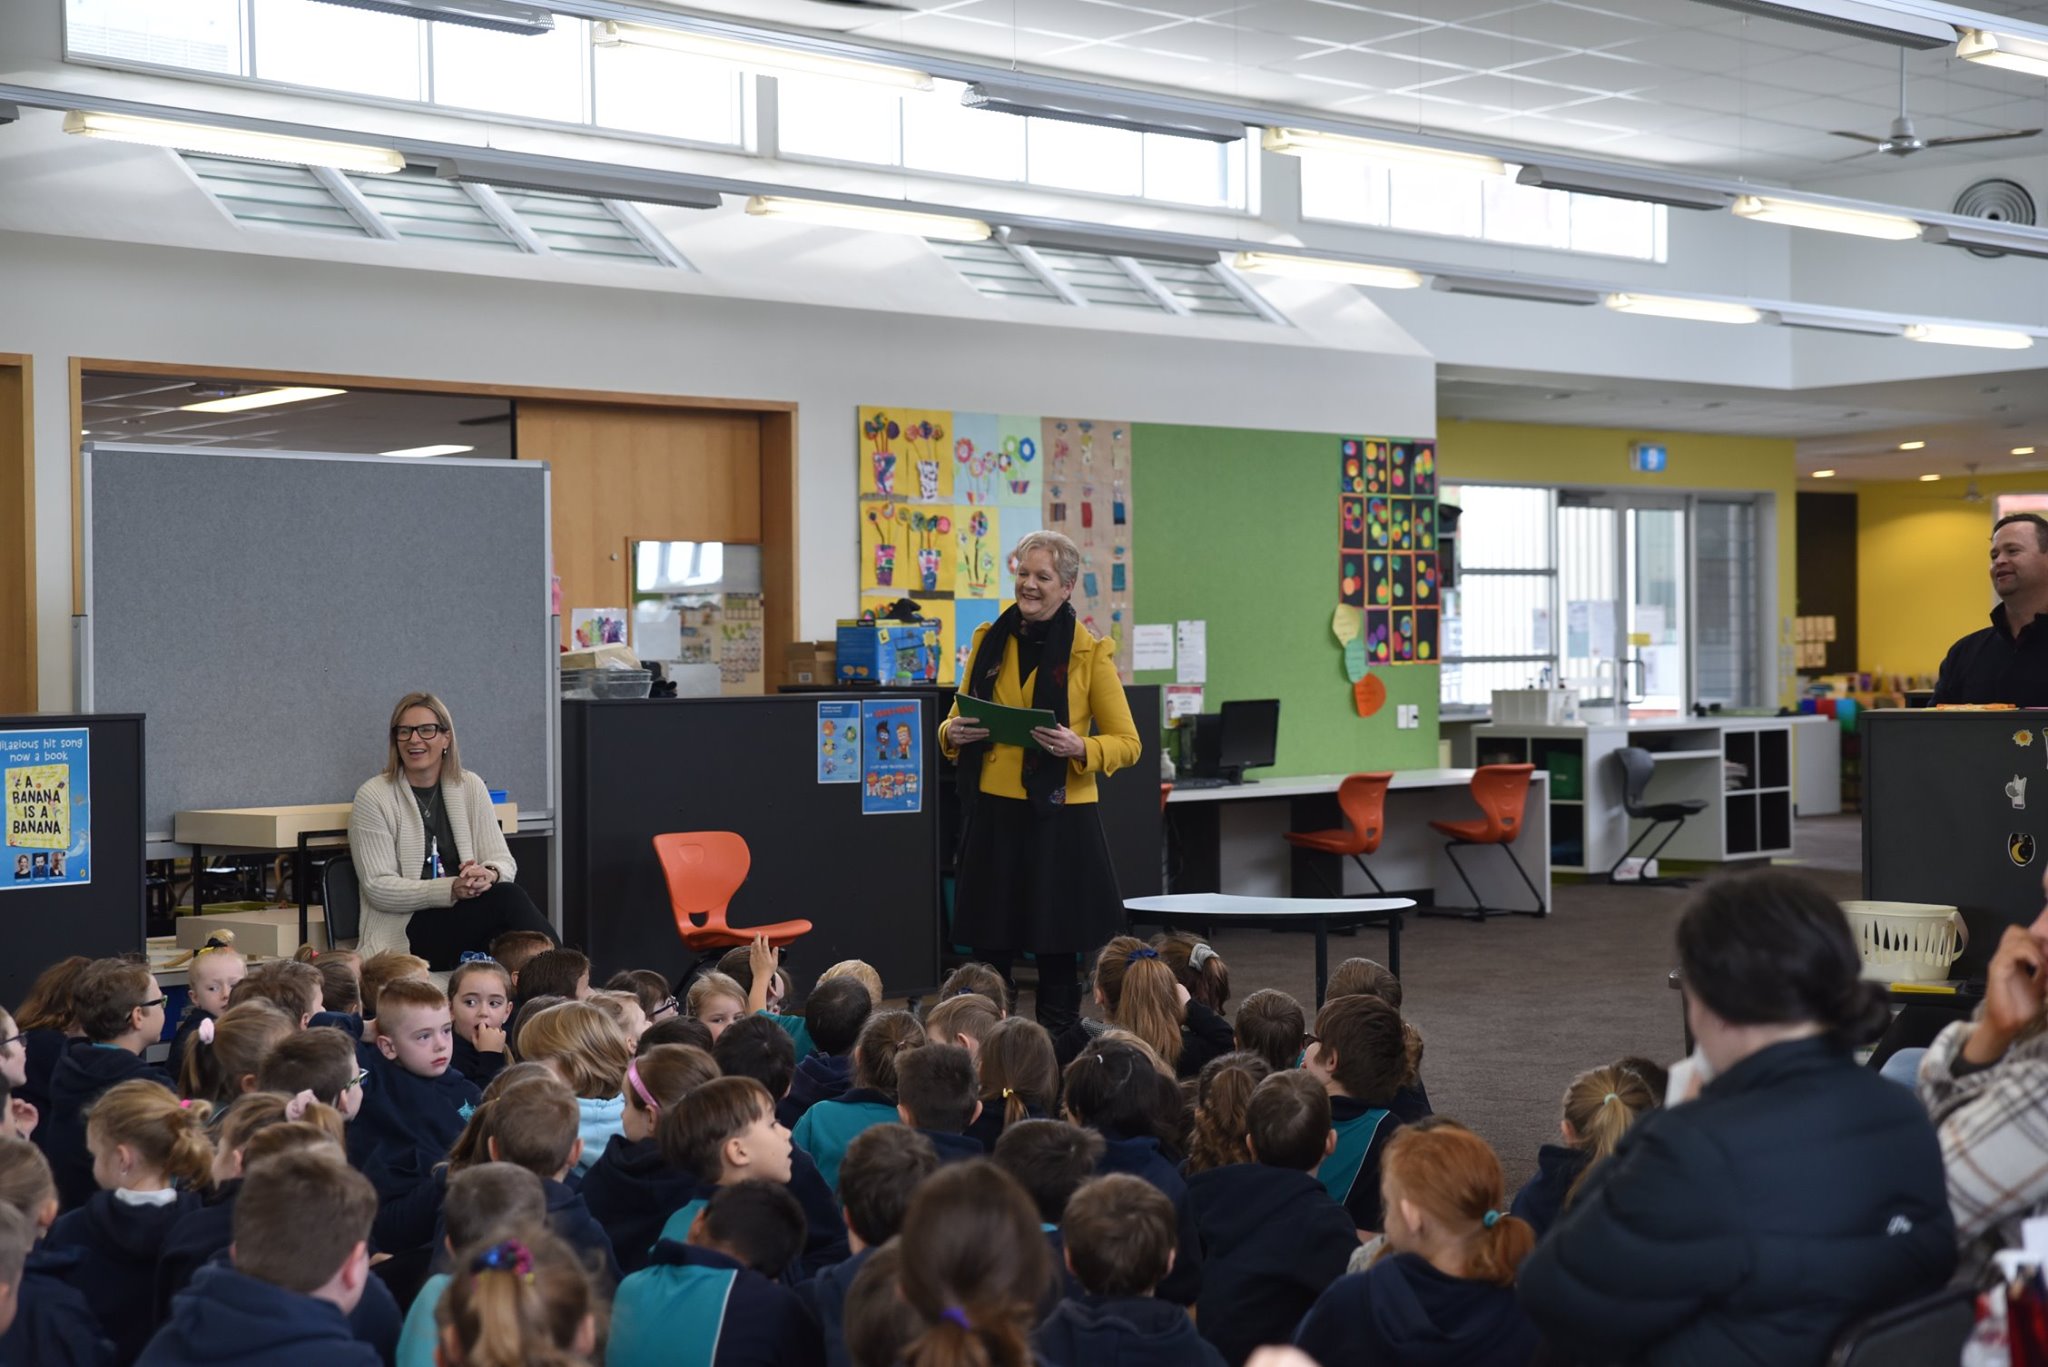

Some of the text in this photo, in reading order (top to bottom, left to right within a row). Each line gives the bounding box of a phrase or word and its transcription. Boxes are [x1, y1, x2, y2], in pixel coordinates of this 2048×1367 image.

[43, 738, 57, 749] hit
[60, 738, 83, 749] song
[9, 751, 69, 762] now a book
[25, 775, 33, 788] A
[12, 789, 61, 804] BANANA
[23, 806, 48, 819] IS A
[13, 820, 61, 834] BANANA
